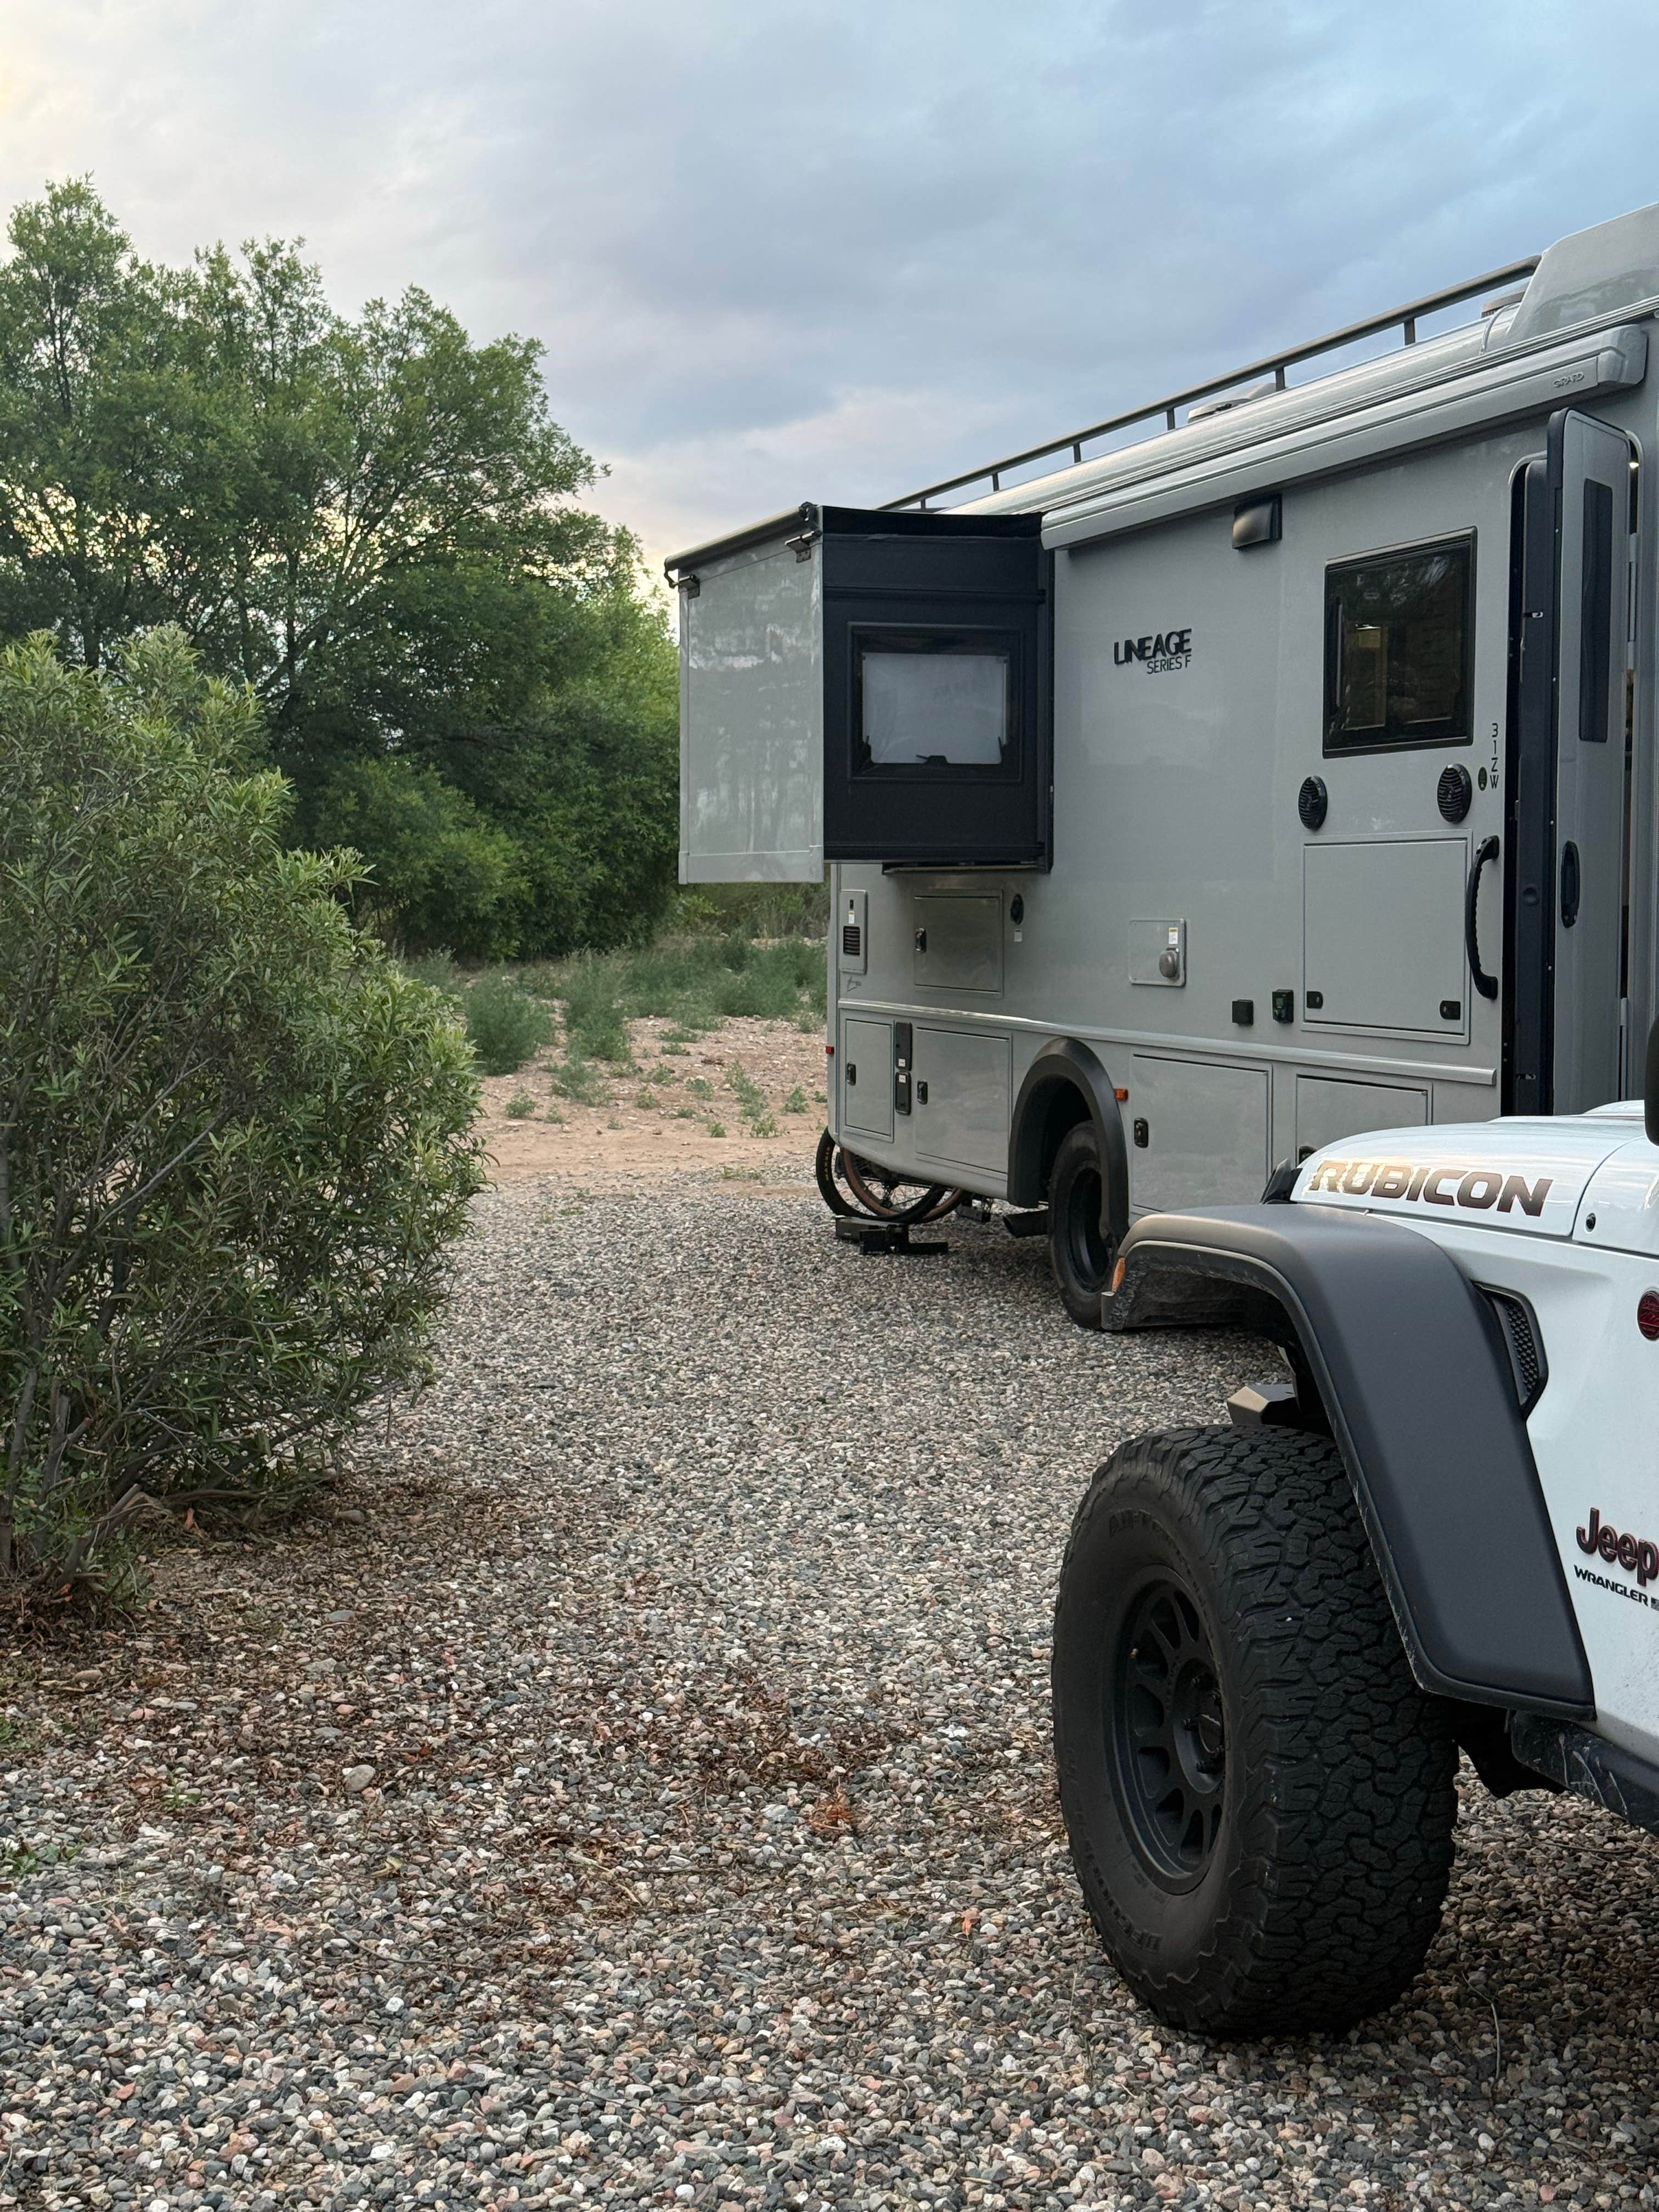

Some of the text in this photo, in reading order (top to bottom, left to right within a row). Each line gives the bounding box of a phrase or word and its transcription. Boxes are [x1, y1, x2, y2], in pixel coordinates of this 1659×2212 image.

[1114, 628, 1192, 665] LINEAGE
[1147, 654, 1192, 674] SERIES F
[1489, 723, 1499, 789] 31ZW
[1308, 1160, 1554, 1217] RUBICON
[1576, 1507, 1658, 1587] Jeep
[1573, 1564, 1649, 1607] WRANGLER
